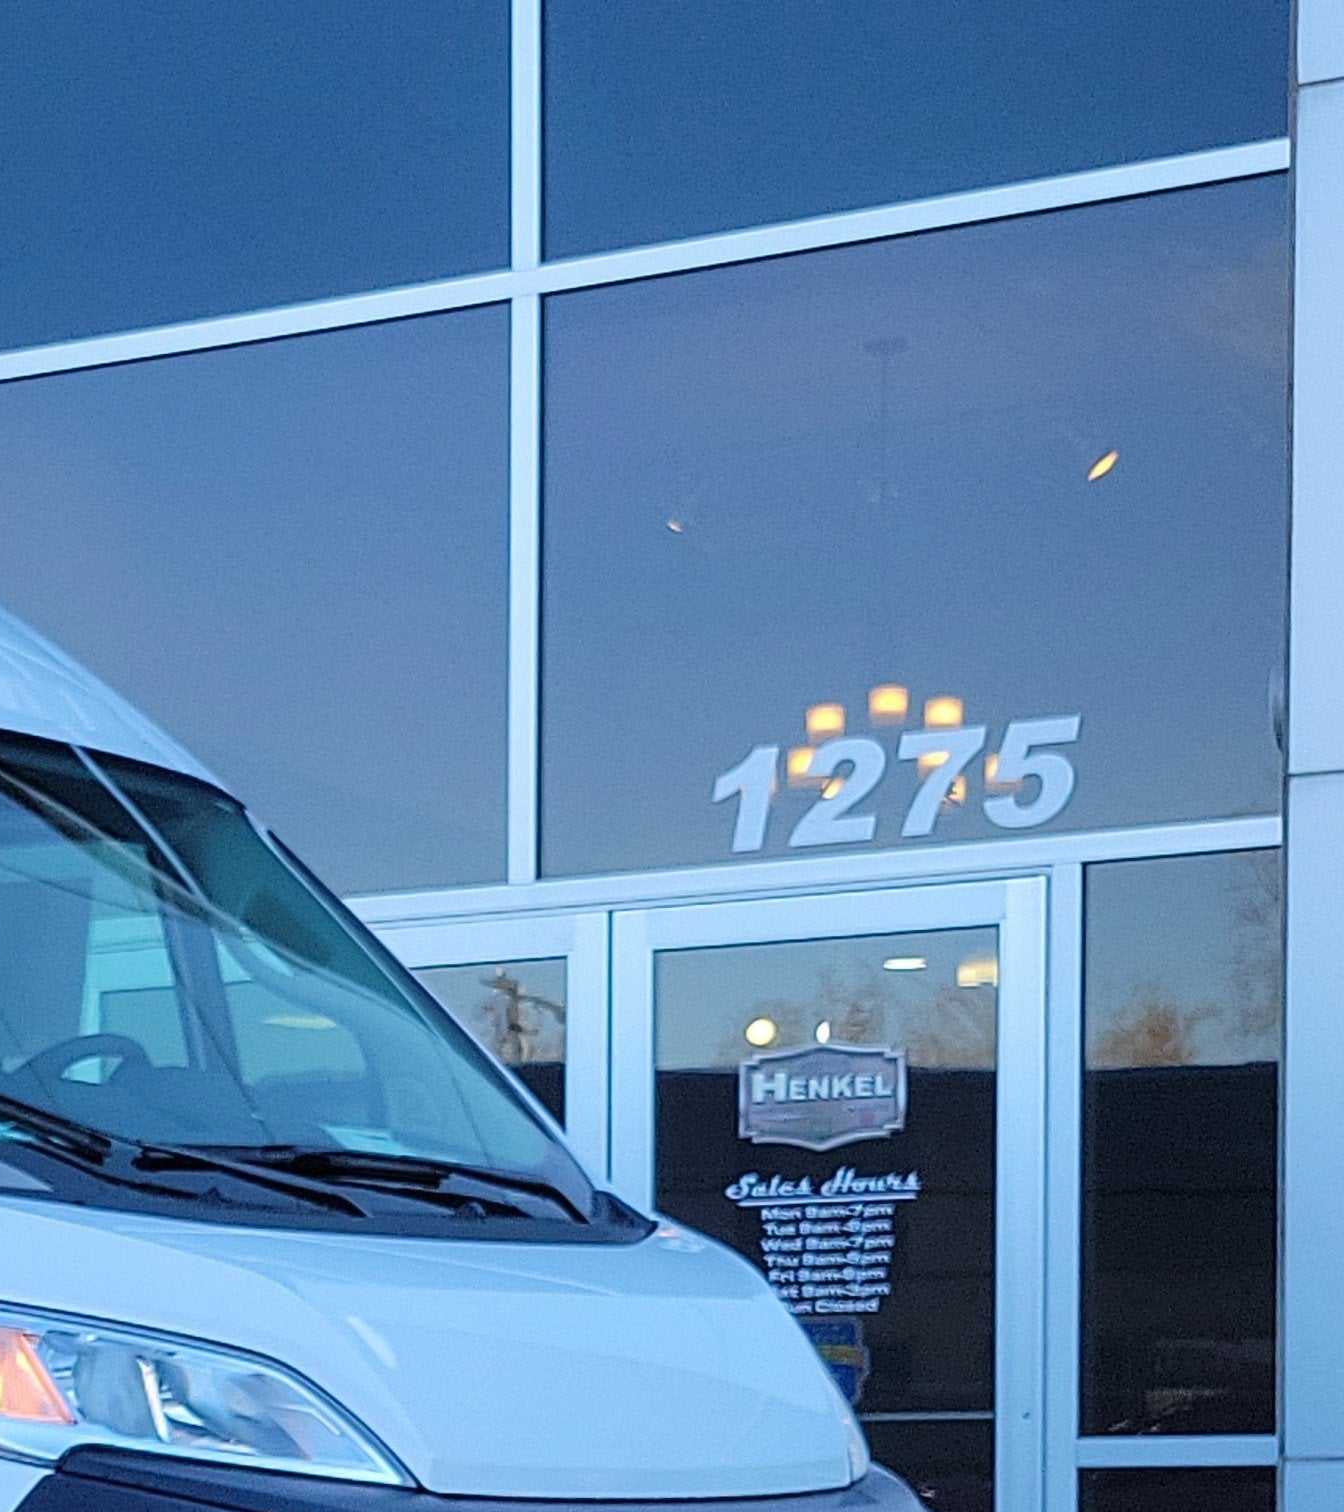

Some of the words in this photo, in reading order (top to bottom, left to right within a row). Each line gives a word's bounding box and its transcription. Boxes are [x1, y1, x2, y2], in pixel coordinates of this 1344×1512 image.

[712, 713, 1081, 853] 1275
[724, 1171, 813, 1200] Sales
[820, 1165, 922, 1197] Hours
